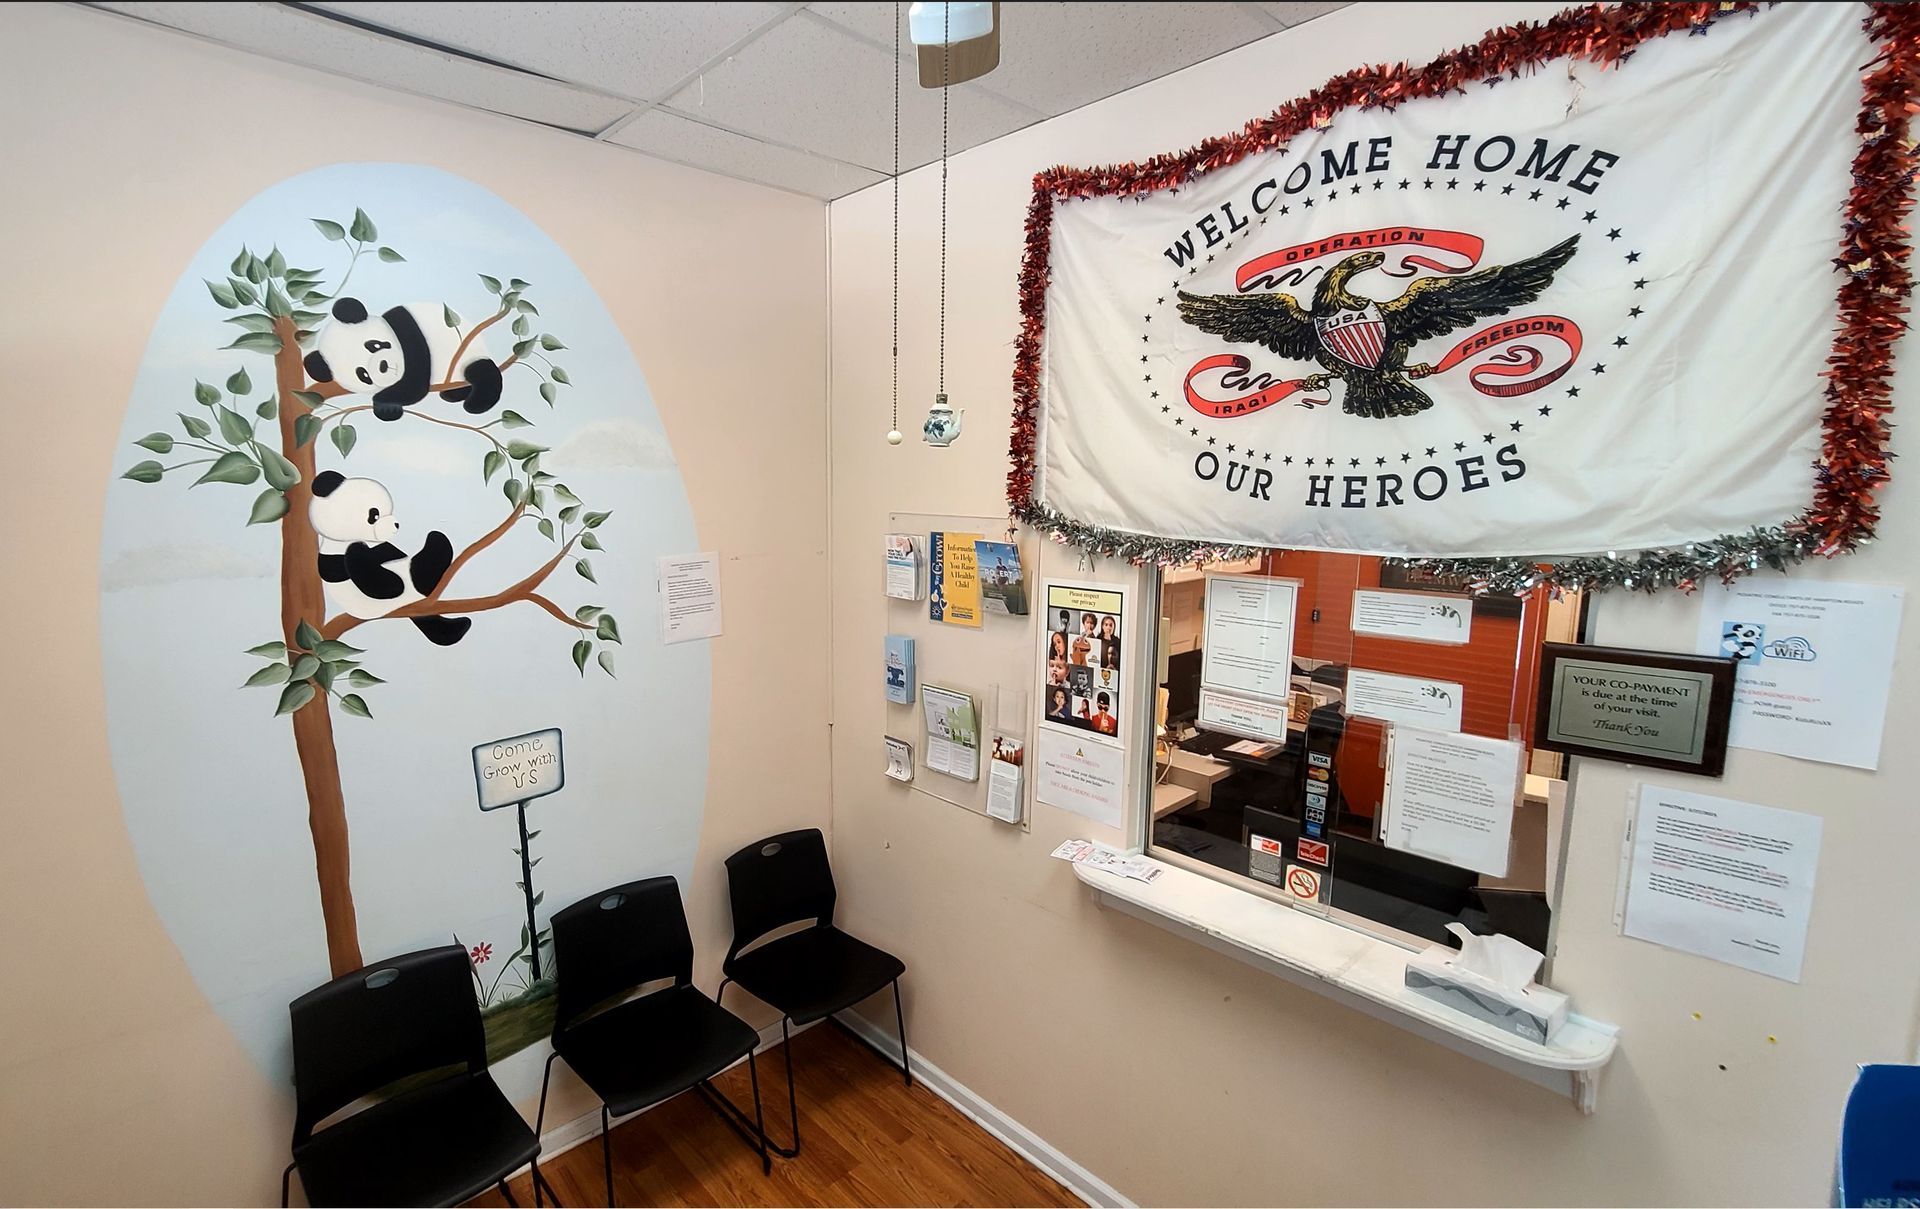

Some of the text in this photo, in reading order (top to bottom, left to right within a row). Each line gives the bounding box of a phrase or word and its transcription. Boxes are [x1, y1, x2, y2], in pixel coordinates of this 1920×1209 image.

[1164, 134, 1620, 269] WELCOME HOME
[1286, 231, 1425, 261] OPERATION
[1328, 312, 1368, 328] USA
[1462, 321, 1564, 355] FREEDOM
[1215, 395, 1267, 414] IRAQI
[1194, 444, 1527, 508] OUR HEROES
[950, 562, 960, 570] You
[960, 553, 973, 563] Help
[955, 572, 975, 581] Healthy
[1774, 647, 1805, 659] WiFi
[1573, 675, 1691, 697] YOUR CO-PAYMENT
[1581, 688, 1678, 708] is due at the time
[1594, 702, 1661, 718] of your visit.
[1593, 719, 1660, 736] Thank You
[493, 739, 543, 760] Come
[483, 752, 557, 780] Grow with
[1311, 755, 1328, 765] VISA
[1307, 782, 1327, 791] DISCOVER
[1300, 850, 1325, 862] TeleCheck
